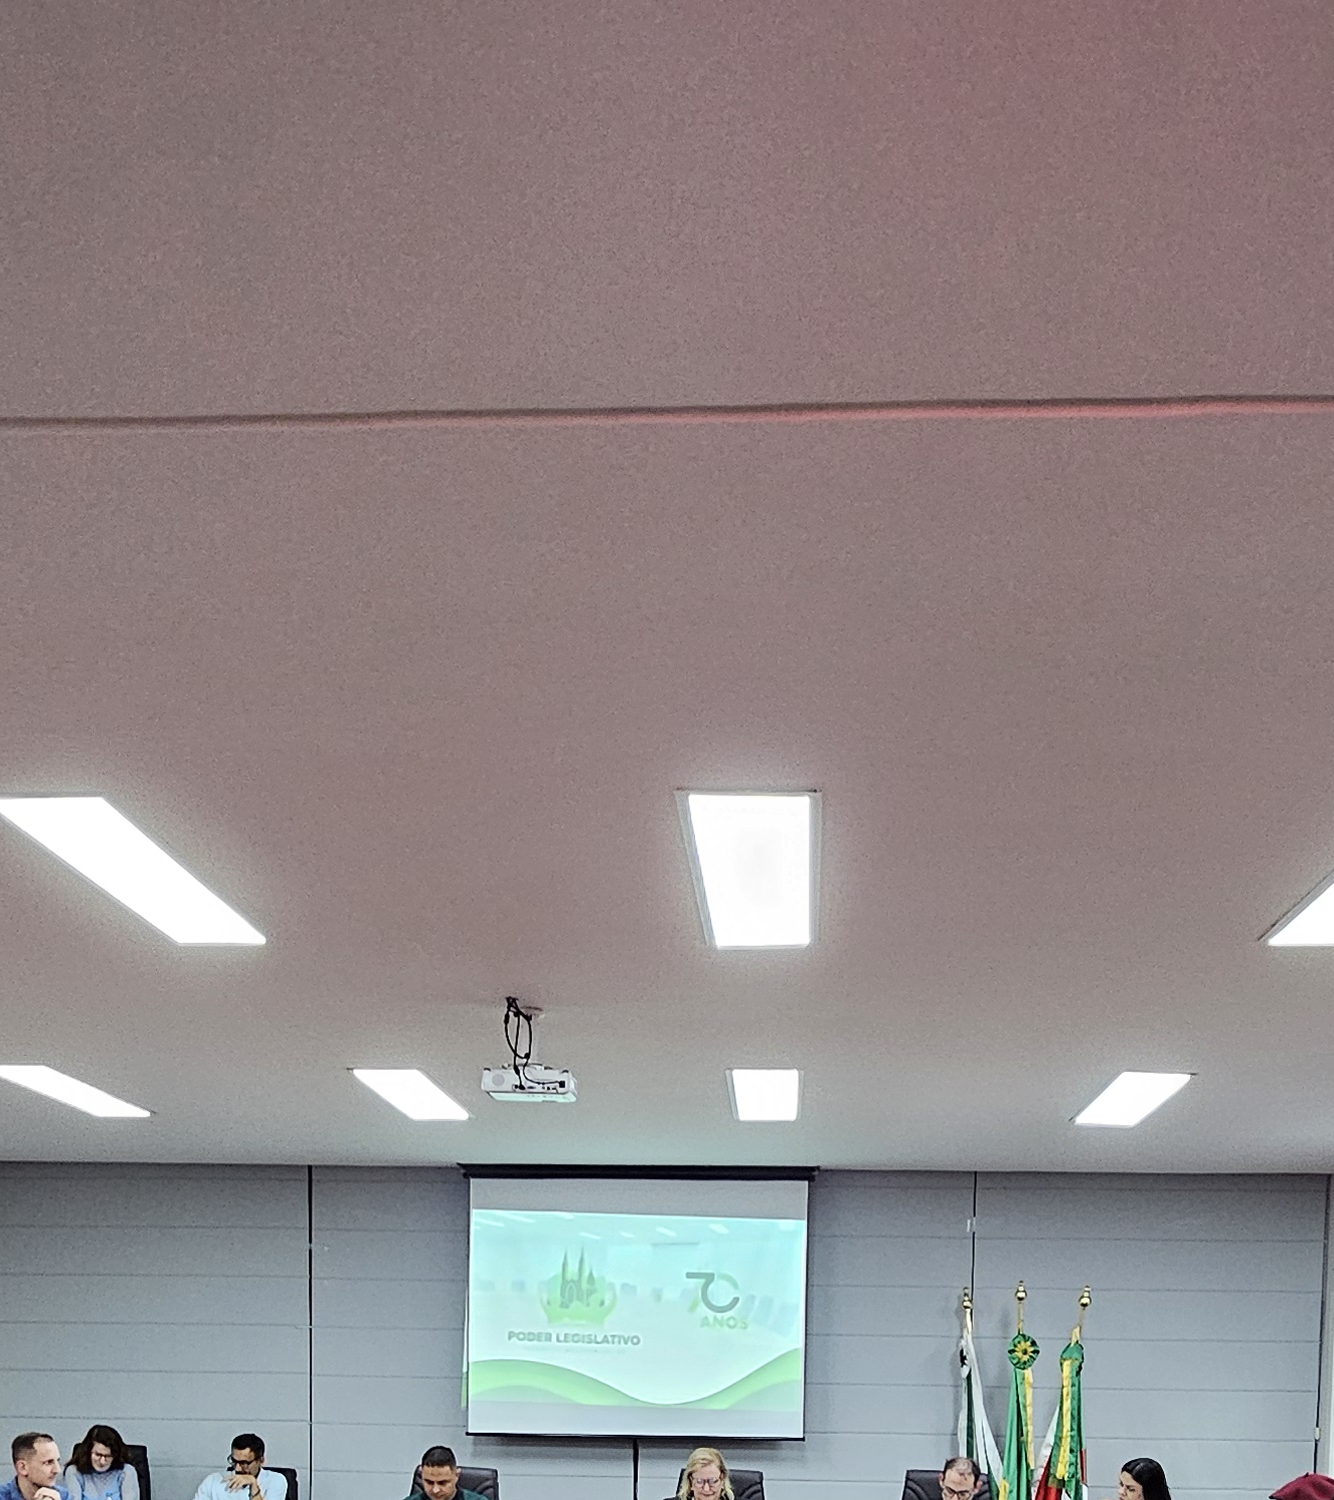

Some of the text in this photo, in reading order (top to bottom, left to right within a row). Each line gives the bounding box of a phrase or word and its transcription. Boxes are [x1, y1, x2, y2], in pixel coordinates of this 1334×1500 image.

[700, 1315, 749, 1330] ANOS
[507, 1330, 642, 1346] PODER LEGISLATIVO
